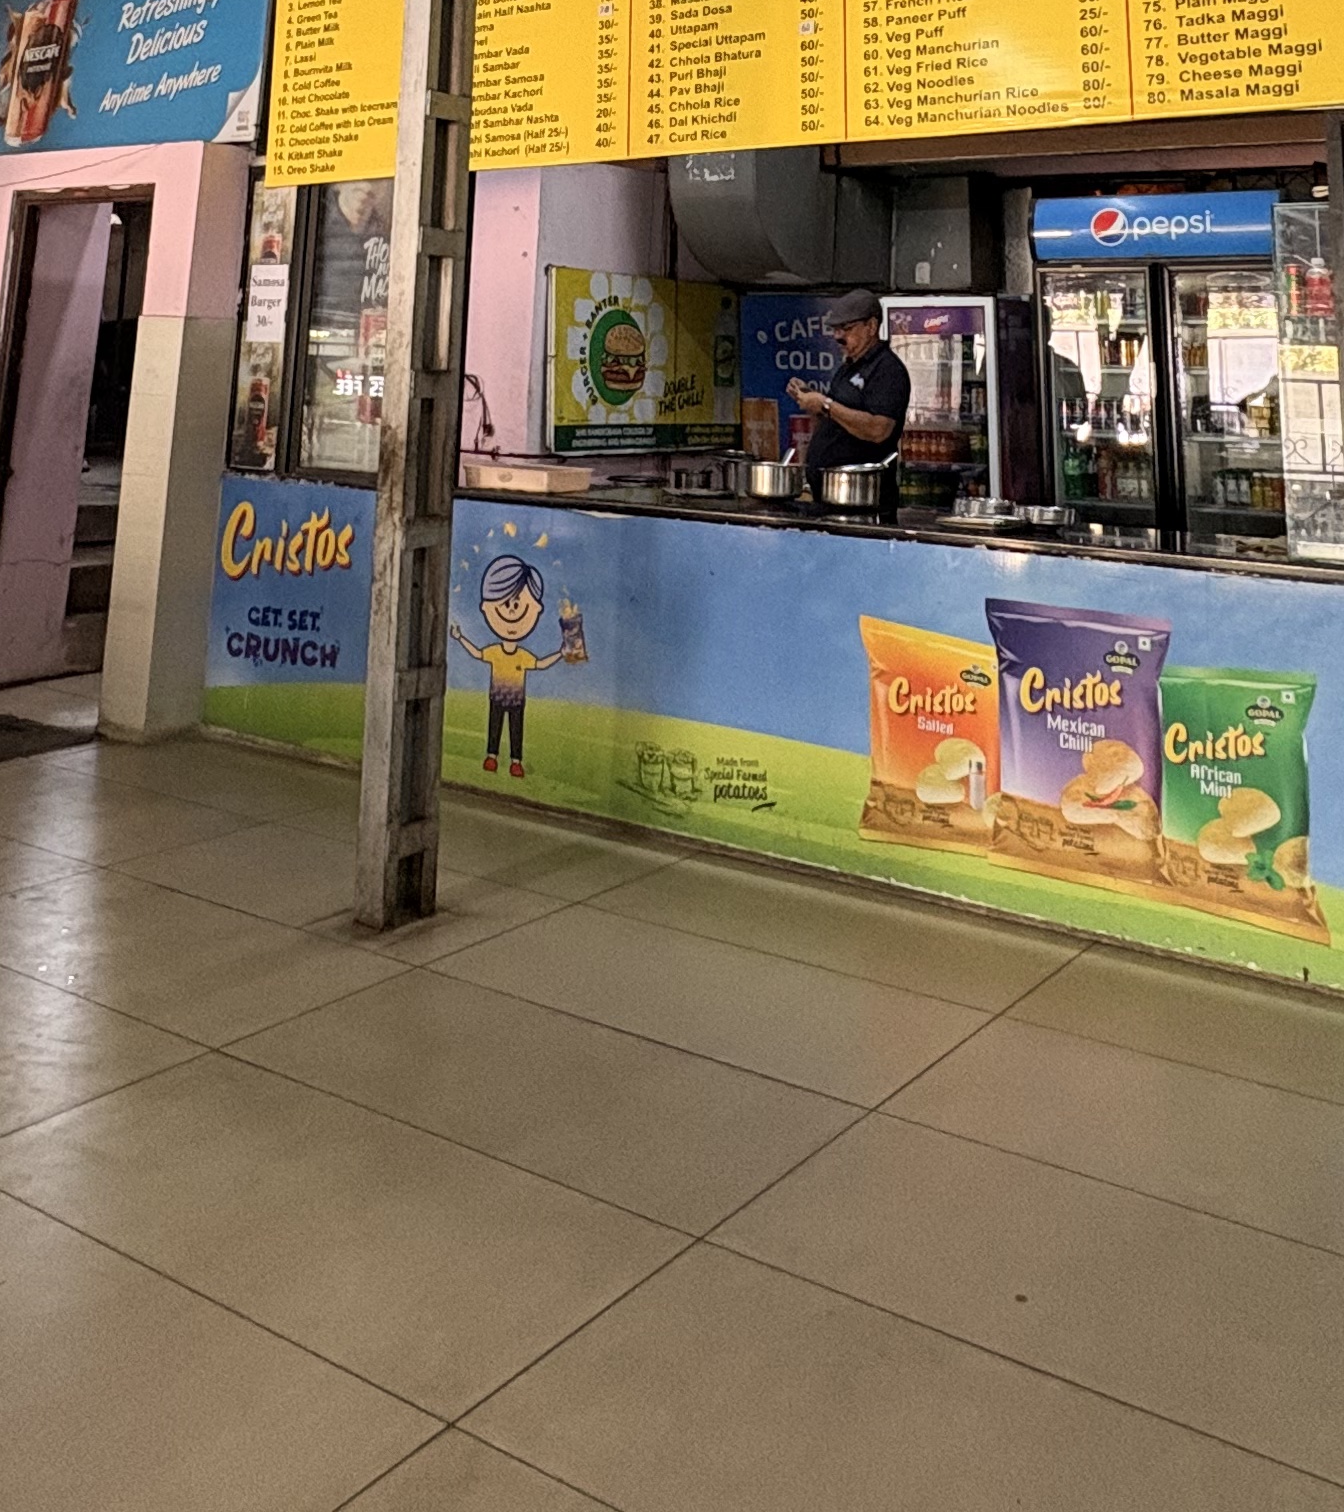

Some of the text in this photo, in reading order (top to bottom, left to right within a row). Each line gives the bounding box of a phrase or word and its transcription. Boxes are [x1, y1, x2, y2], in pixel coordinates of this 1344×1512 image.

[649, 0, 665, 10] 38.
[863, 0, 882, 12] 57.
[126, 20, 207, 65] Delicious
[99, 61, 222, 115] Anytime Anywhere
[647, 119, 824, 144] 47. Curd Rice 50/-
[1132, 210, 1212, 242] pepsi
[585, 295, 620, 330] BANTER
[776, 350, 834, 370] COLD
[659, 398, 676, 415] THE
[220, 500, 354, 581] Cristos
[226, 631, 339, 668] CRUNCH
[1106, 655, 1138, 667] GOPAL
[889, 676, 976, 714] Cristos
[1019, 667, 1122, 714] Cristos
[1247, 707, 1283, 721] GOPAL
[1047, 715, 1105, 739] Mexican
[1059, 733, 1093, 753] Chilli
[1164, 722, 1265, 764] Cristos
[704, 767, 734, 783] Special
[1191, 764, 1242, 784] African
[714, 783, 768, 803] potatoes
[1200, 781, 1231, 798] Mint
